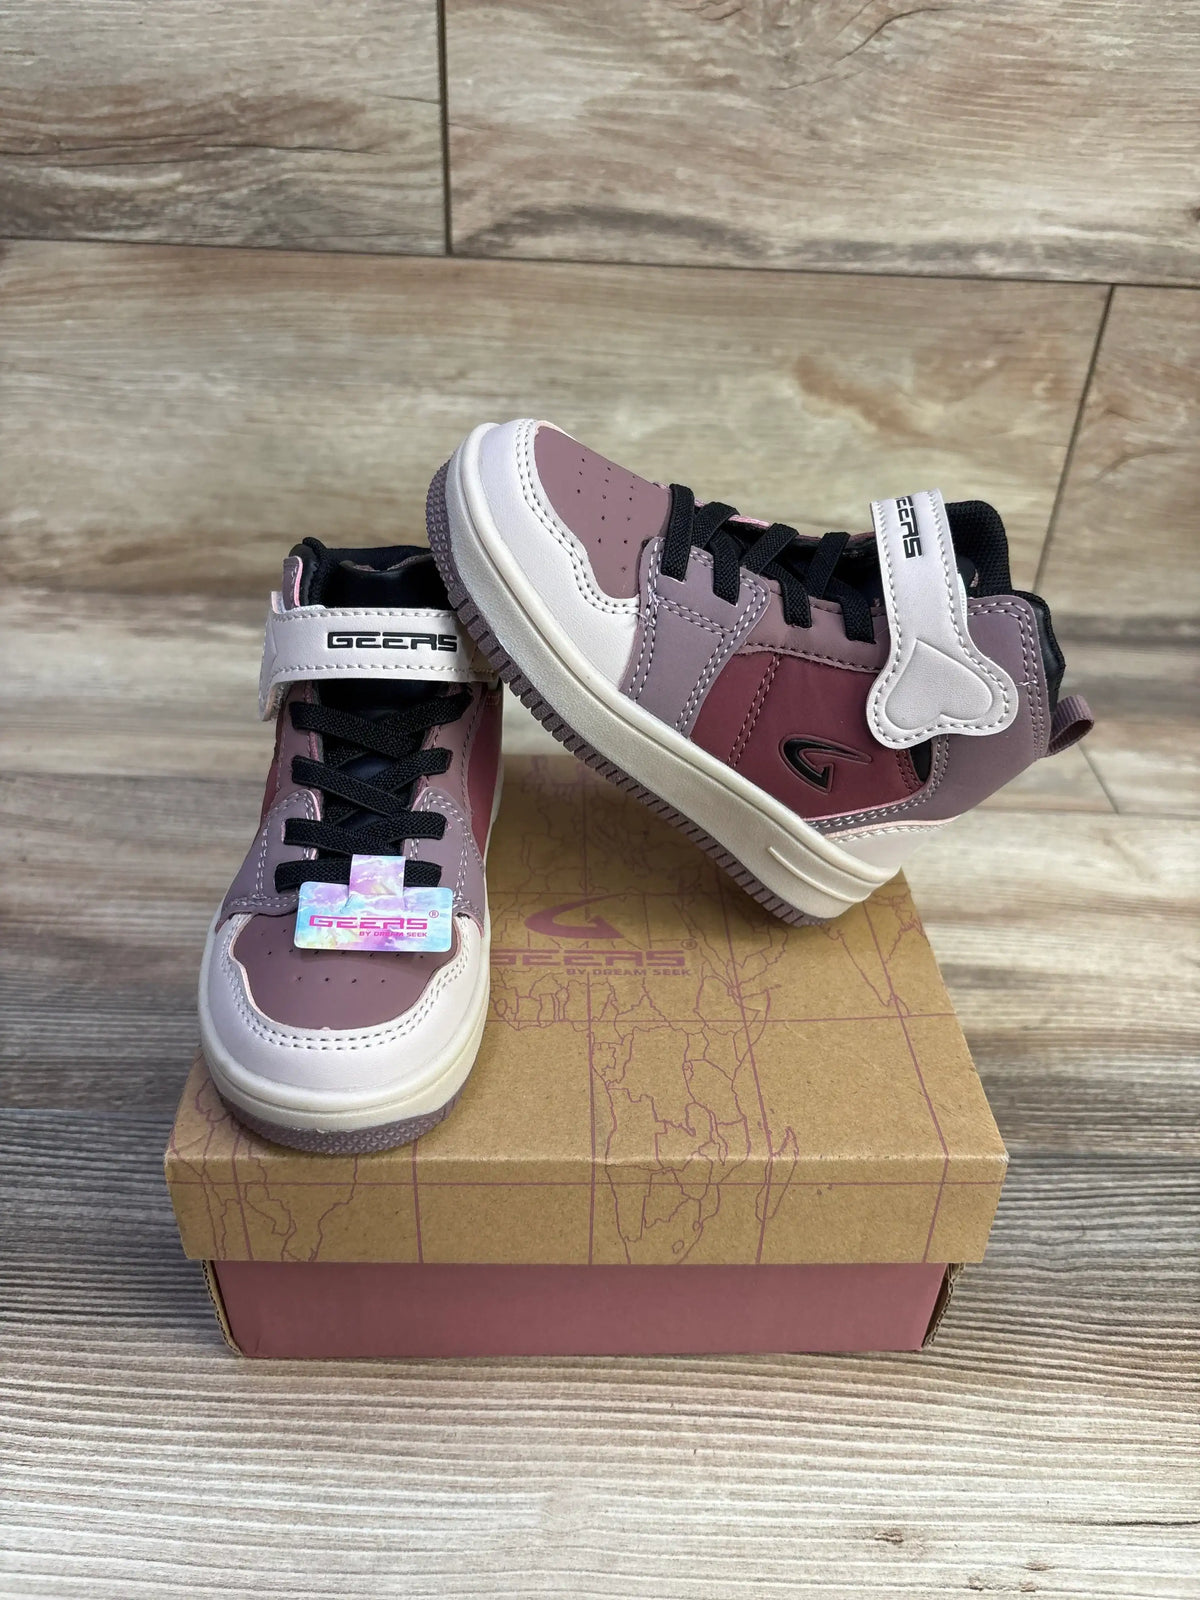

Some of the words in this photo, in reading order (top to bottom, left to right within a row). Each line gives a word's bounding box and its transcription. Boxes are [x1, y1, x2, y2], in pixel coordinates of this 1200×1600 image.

[896, 496, 922, 558] EERS
[327, 631, 457, 652] GEERS
[309, 915, 428, 930] GEERS
[566, 968, 586, 976] BY
[592, 968, 647, 976] DREAM
